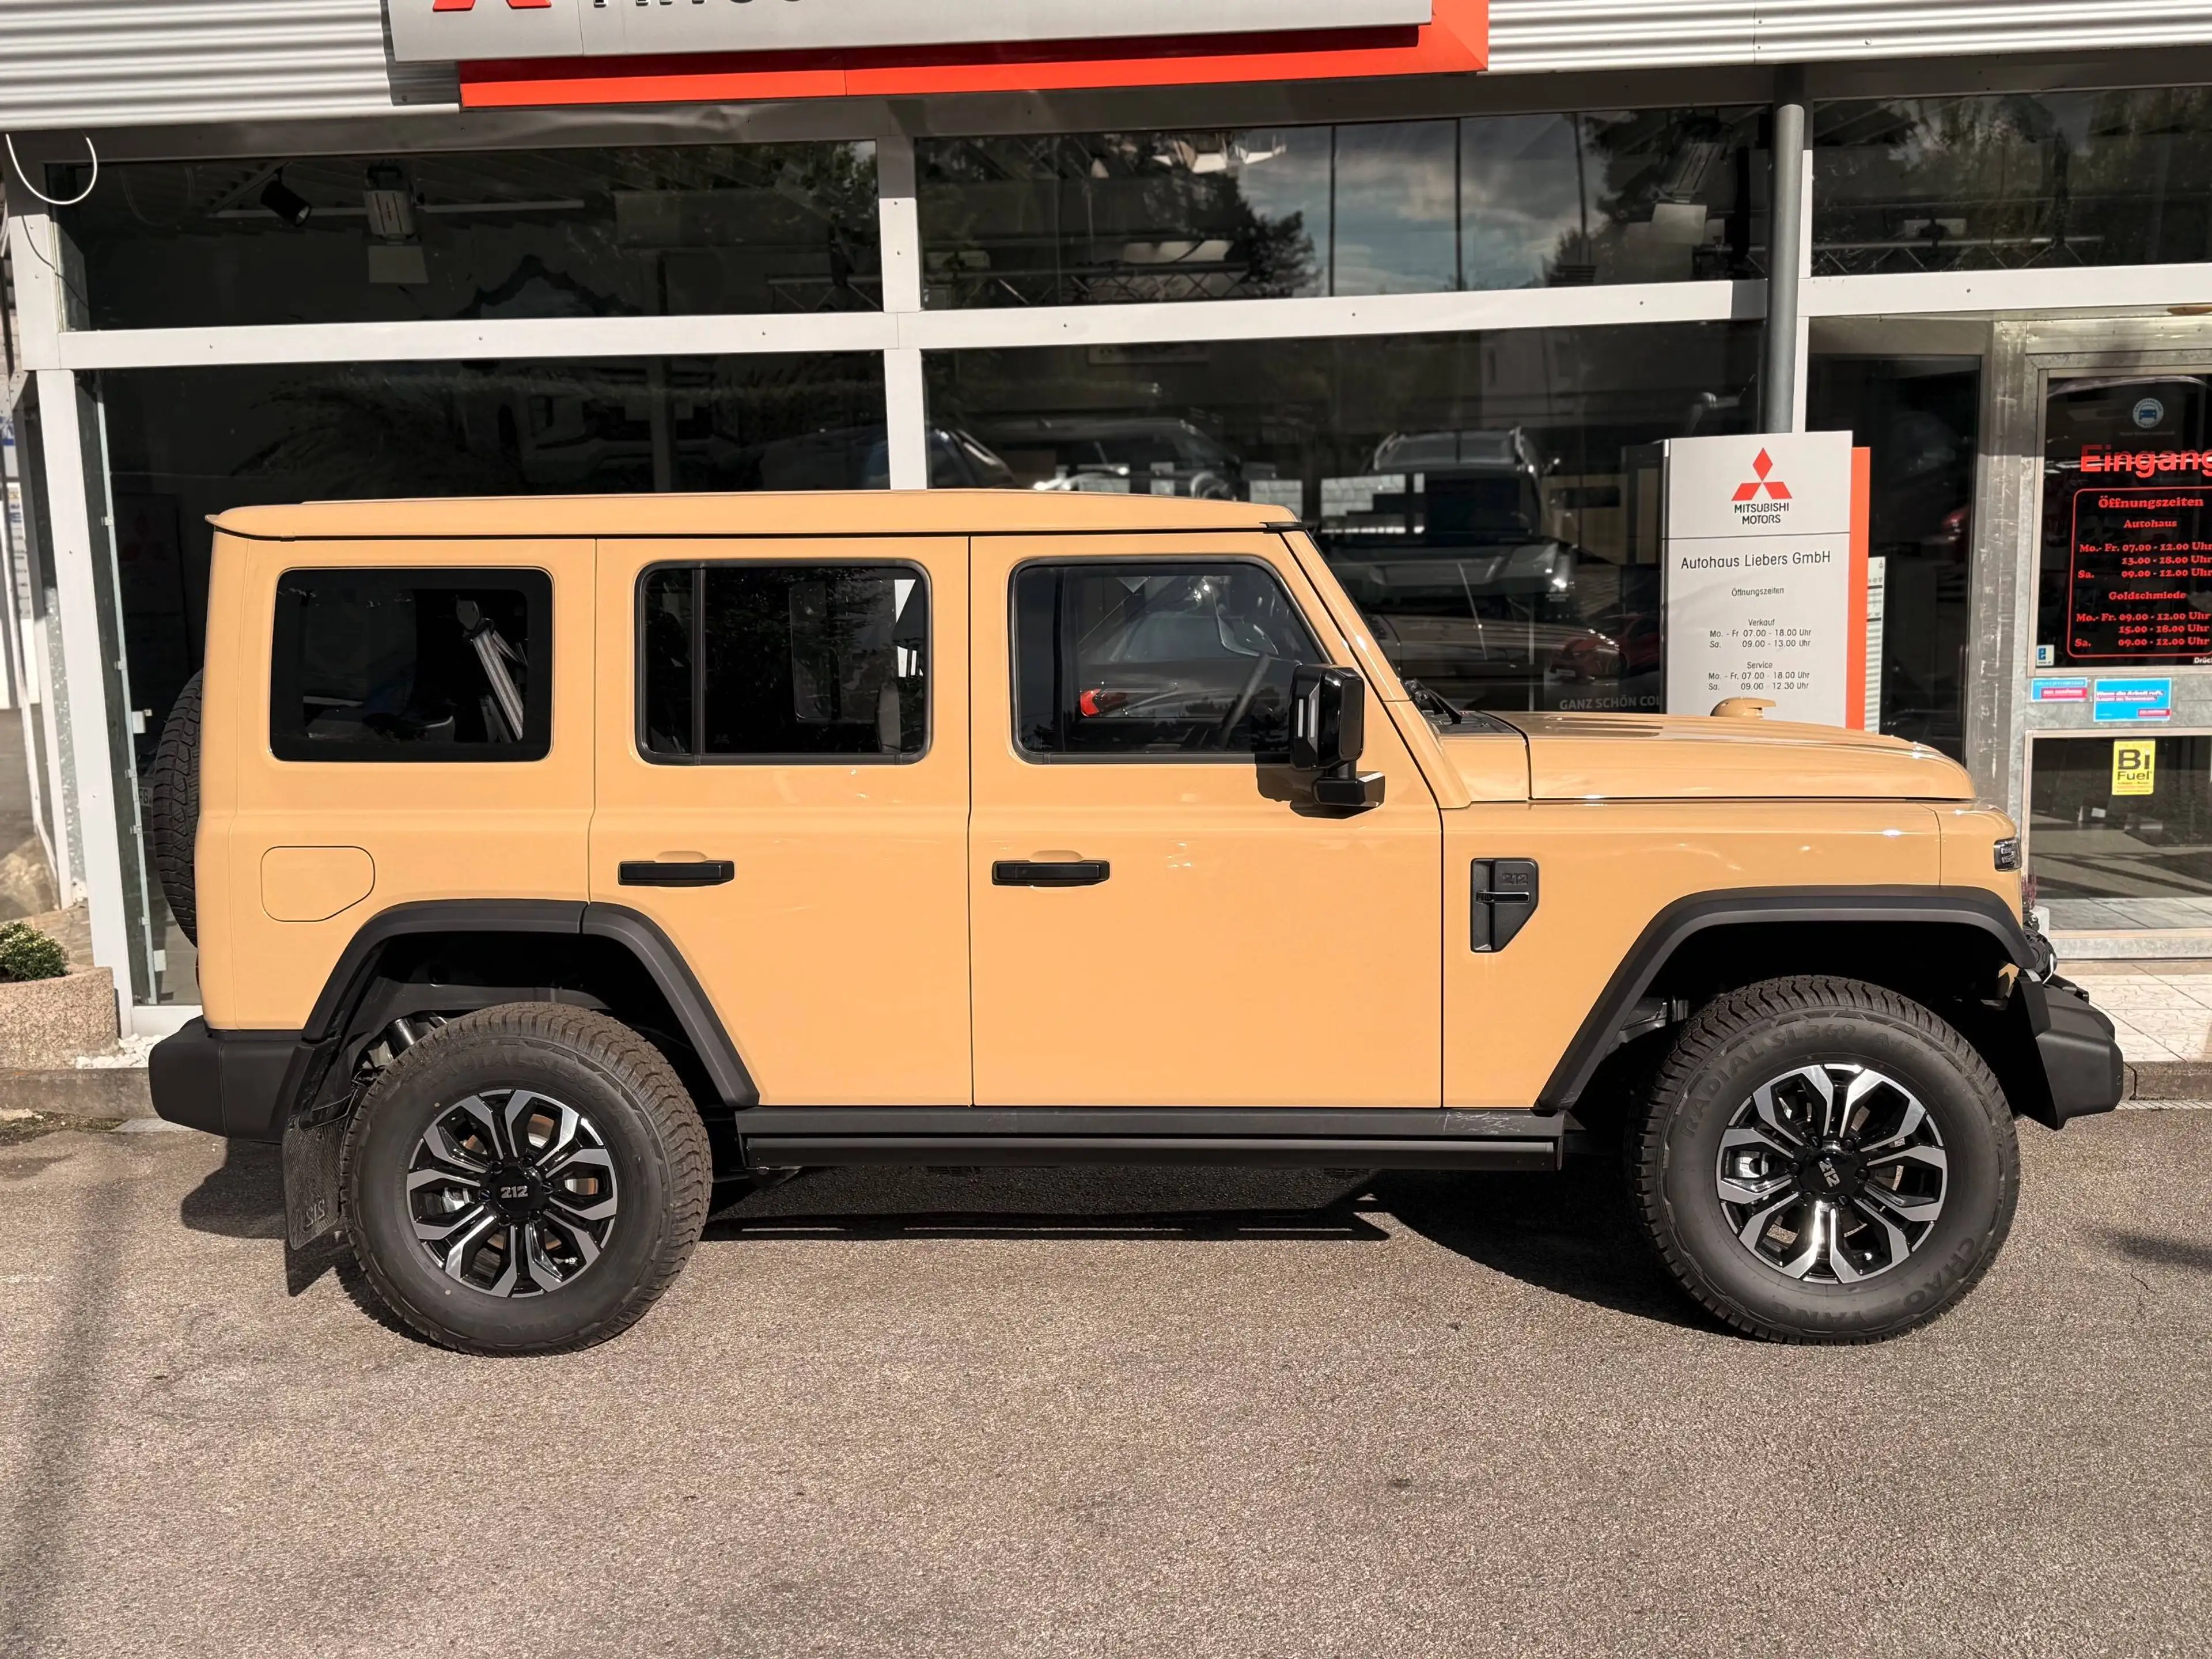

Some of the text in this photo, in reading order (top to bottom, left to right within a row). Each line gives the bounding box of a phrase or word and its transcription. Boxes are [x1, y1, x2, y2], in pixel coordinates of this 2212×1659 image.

[1734, 502, 1789, 513] MITSUBISHI
[2098, 495, 2203, 510] Öffnungszeiten
[1742, 514, 1781, 525] MOTORS
[2123, 519, 2177, 528] Autohaus
[2104, 543, 2120, 552] Fr.
[2122, 544, 2152, 553] 07.00
[2160, 543, 2189, 551] 12.00
[2192, 541, 2212, 551] Uhr
[1681, 551, 1831, 569] Autohaus Liebers GmbH
[2122, 556, 2151, 566] 13.00
[2159, 556, 2188, 565] 18.00
[2191, 555, 2212, 563] Uhr
[2078, 570, 2094, 578] Sa.
[2121, 570, 2151, 578] 09.00
[2160, 569, 2188, 577] 12.00
[2191, 568, 2212, 577] Uhr
[1732, 588, 1784, 597] Öffnungszeiten
[2108, 590, 2187, 600] Goldschmiede
[2101, 613, 2116, 622] Fr.
[2119, 613, 2149, 622] 09.00
[2188, 611, 2211, 620] Uhr
[1748, 619, 1775, 627] Verkauf
[1743, 629, 1766, 637] 07.00
[2119, 626, 2147, 634] 15.00
[2156, 624, 2185, 633] 18.00
[2187, 624, 2210, 632] Uhr
[1710, 640, 1721, 648] Sa.
[1774, 639, 1796, 647] 13.00
[2074, 638, 2092, 647] Sa.
[2118, 639, 2147, 647] 09.00
[2156, 638, 2185, 646] 12.00
[2187, 637, 2210, 645] Uhr
[1741, 672, 1764, 680] 07.00
[1774, 671, 1796, 679] 18.00
[1708, 683, 1720, 691] Sa.
[1560, 699, 1593, 710] GANZ
[1594, 695, 1637, 709] SCHÖN
[2118, 749, 2150, 770] Bi
[1502, 873, 1529, 885] 212
[1680, 1045, 1765, 1140] RADIAL
[1819, 1157, 1840, 1188] 212
[500, 1185, 528, 1199] 212
[1902, 1237, 1977, 1310] CHAO
